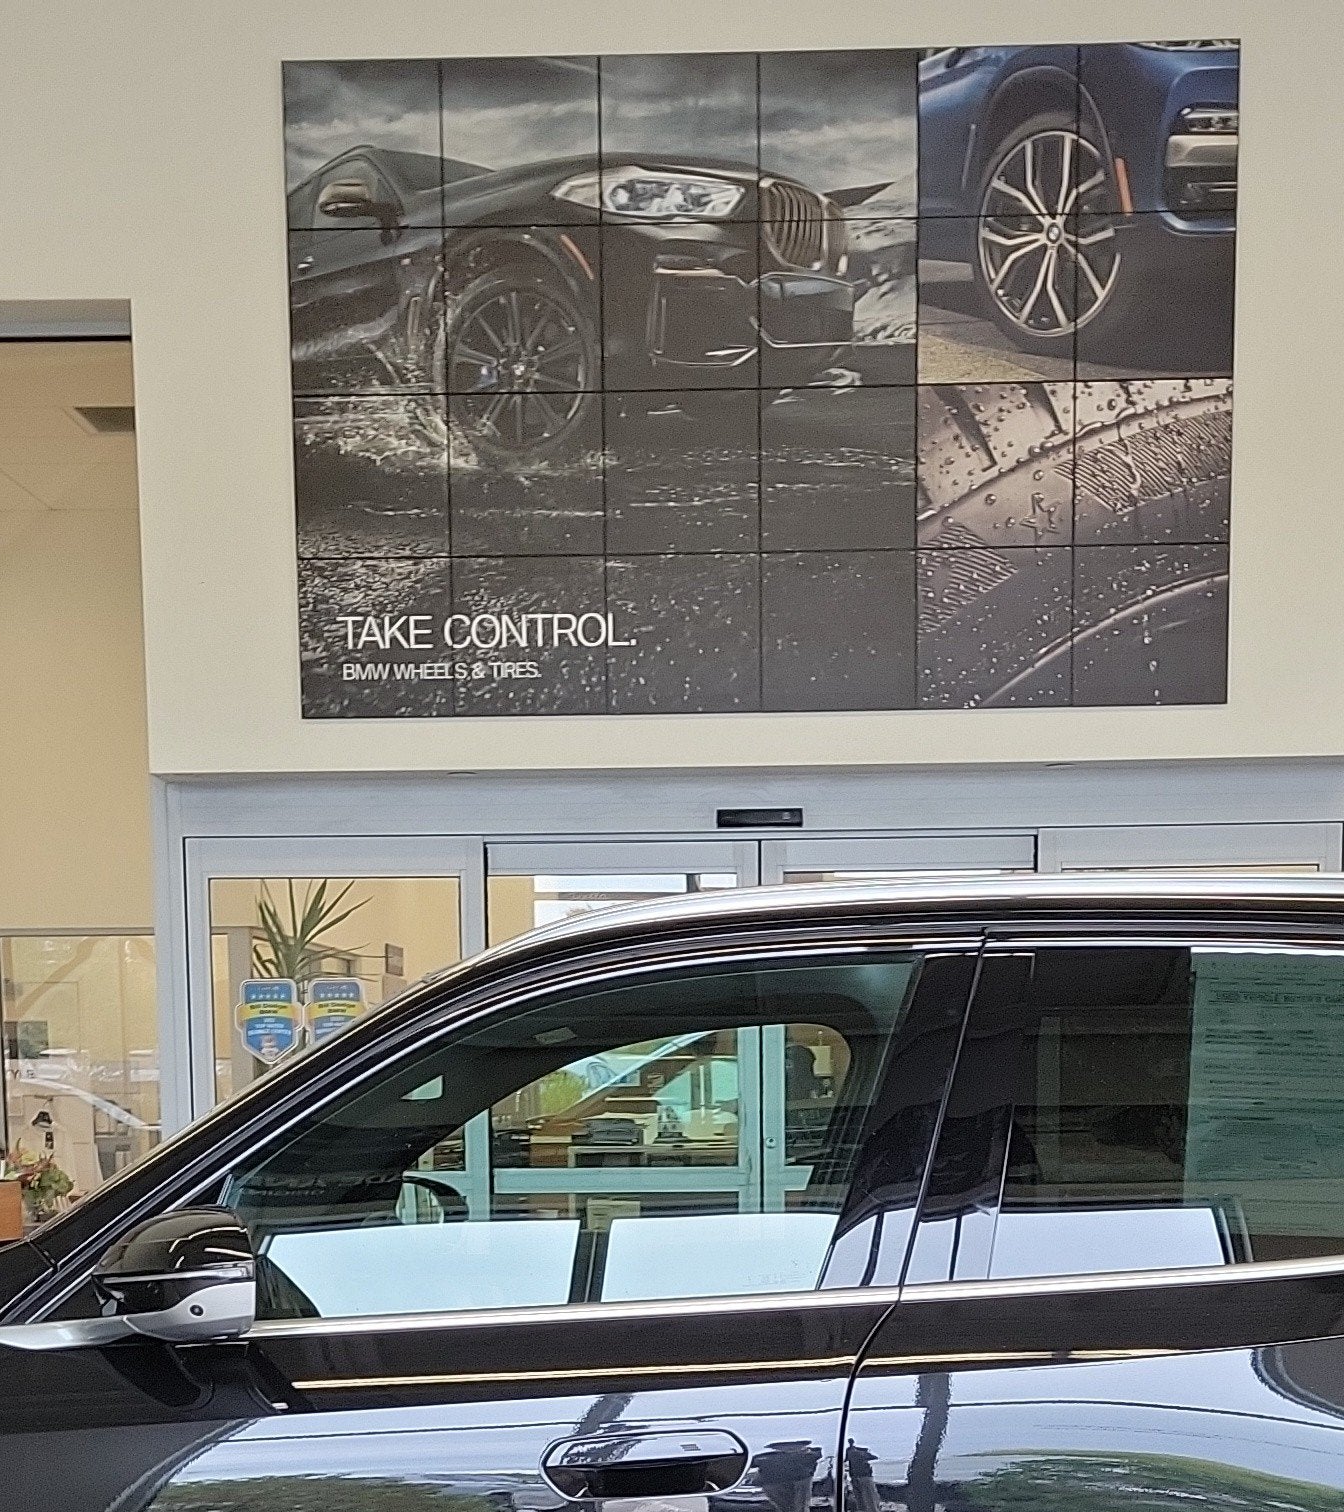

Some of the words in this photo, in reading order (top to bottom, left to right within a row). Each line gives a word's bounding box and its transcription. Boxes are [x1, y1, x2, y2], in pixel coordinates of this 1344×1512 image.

[336, 614, 434, 650] TAKE
[443, 612, 638, 649] CONTROL.
[342, 663, 390, 681] BMW
[392, 662, 468, 680] WHEELS
[471, 661, 486, 680] &
[489, 661, 542, 679] TIRES.
